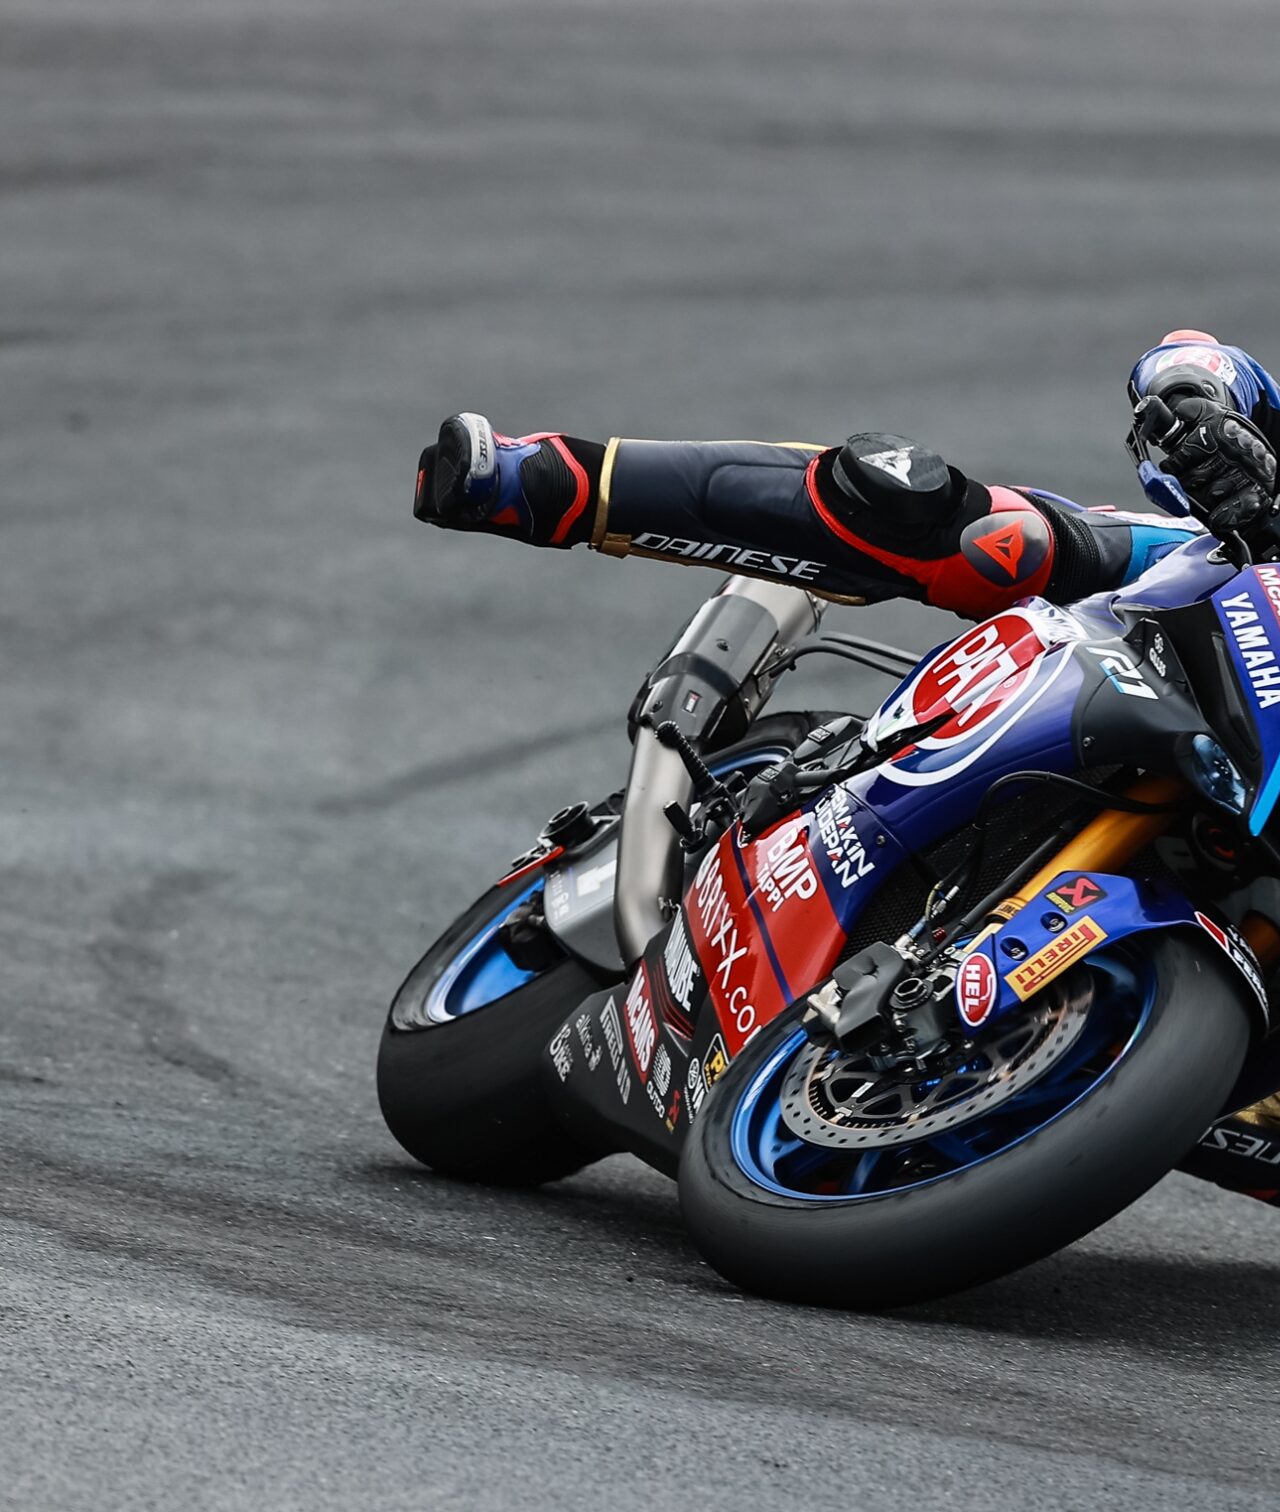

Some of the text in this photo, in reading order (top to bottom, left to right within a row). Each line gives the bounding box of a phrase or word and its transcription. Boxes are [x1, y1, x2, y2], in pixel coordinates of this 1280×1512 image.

[631, 532, 828, 581] DAINESE
[933, 624, 1020, 728] PATA
[767, 826, 818, 900] BMP
[817, 805, 860, 889] DEPAN
[755, 861, 785, 912] TAPPI
[964, 963, 982, 1013] HEL
[1015, 923, 1098, 993] PIRELLI
